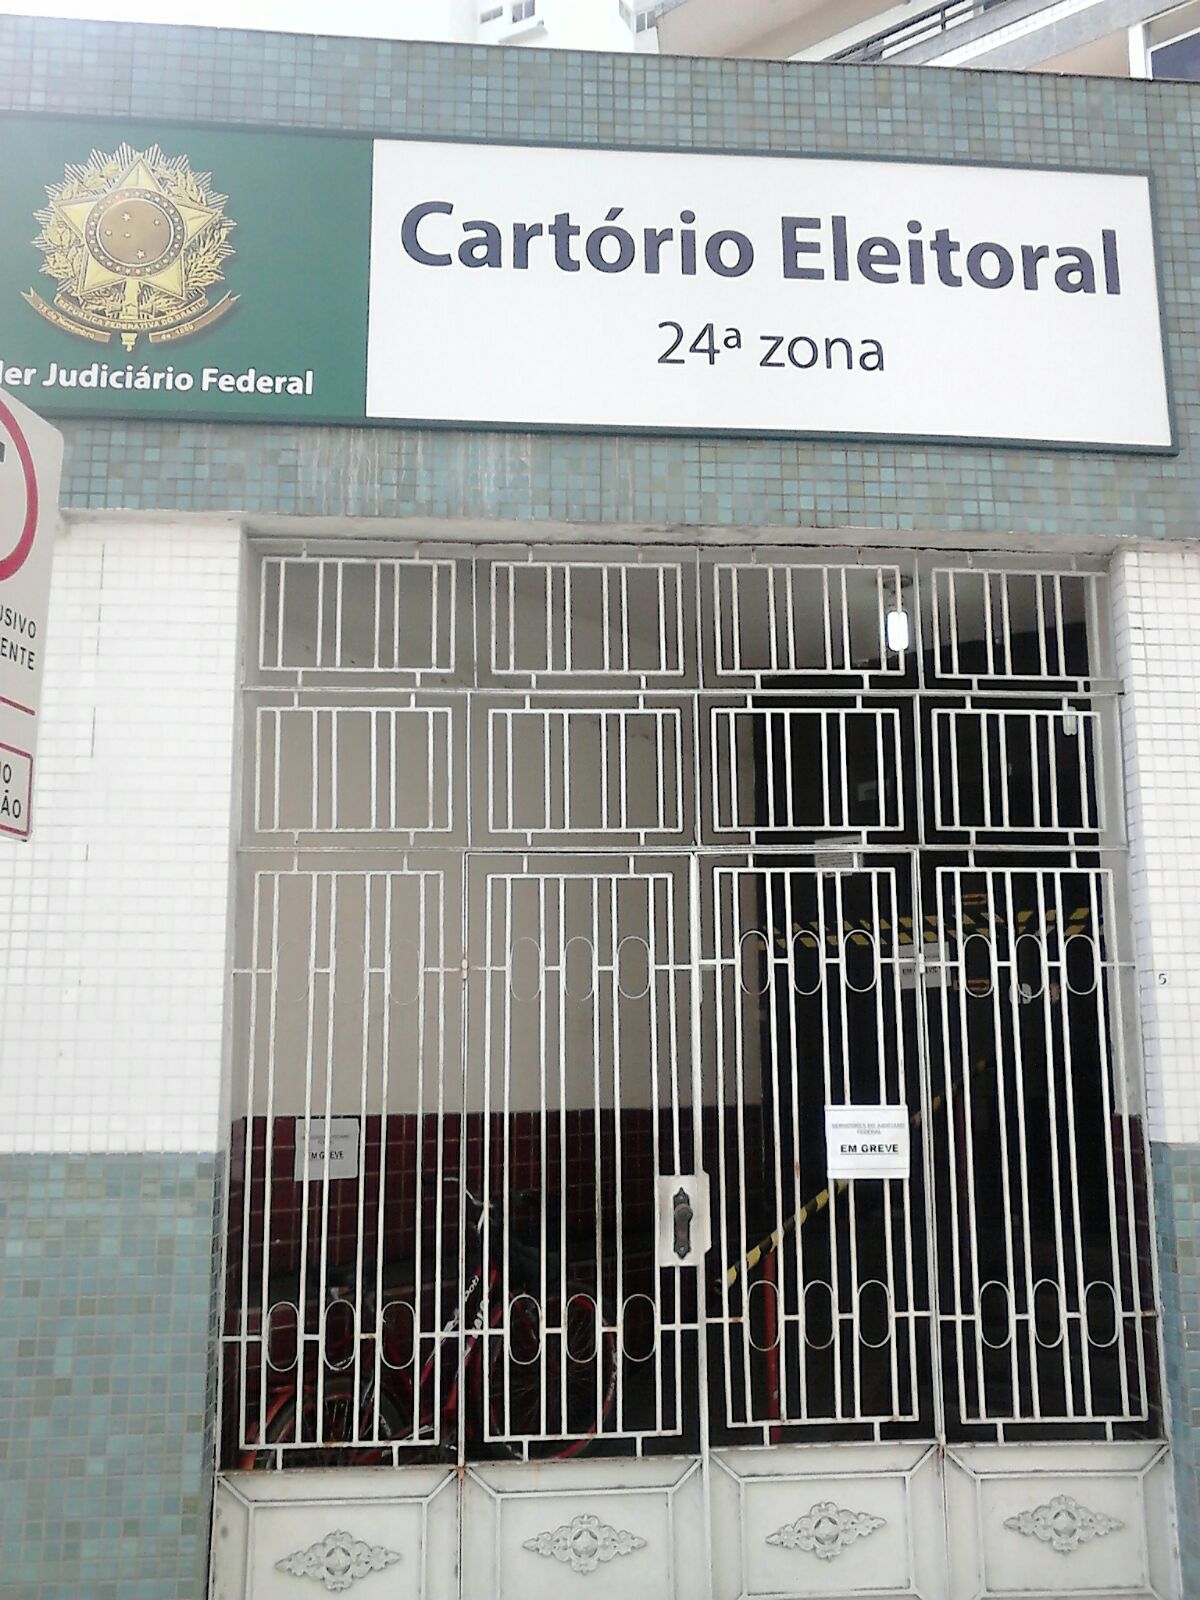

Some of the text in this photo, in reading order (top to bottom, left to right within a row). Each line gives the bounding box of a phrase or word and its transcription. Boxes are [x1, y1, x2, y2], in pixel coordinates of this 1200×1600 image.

[401, 201, 1121, 295] Cartório Eleitoral
[656, 320, 885, 371] 24ª zona
[0, 359, 314, 395] er Judiciário Federal
[1158, 973, 1167, 985] 5
[319, 1150, 345, 1160] GEVE
[840, 1143, 899, 1153] EM GREVE
